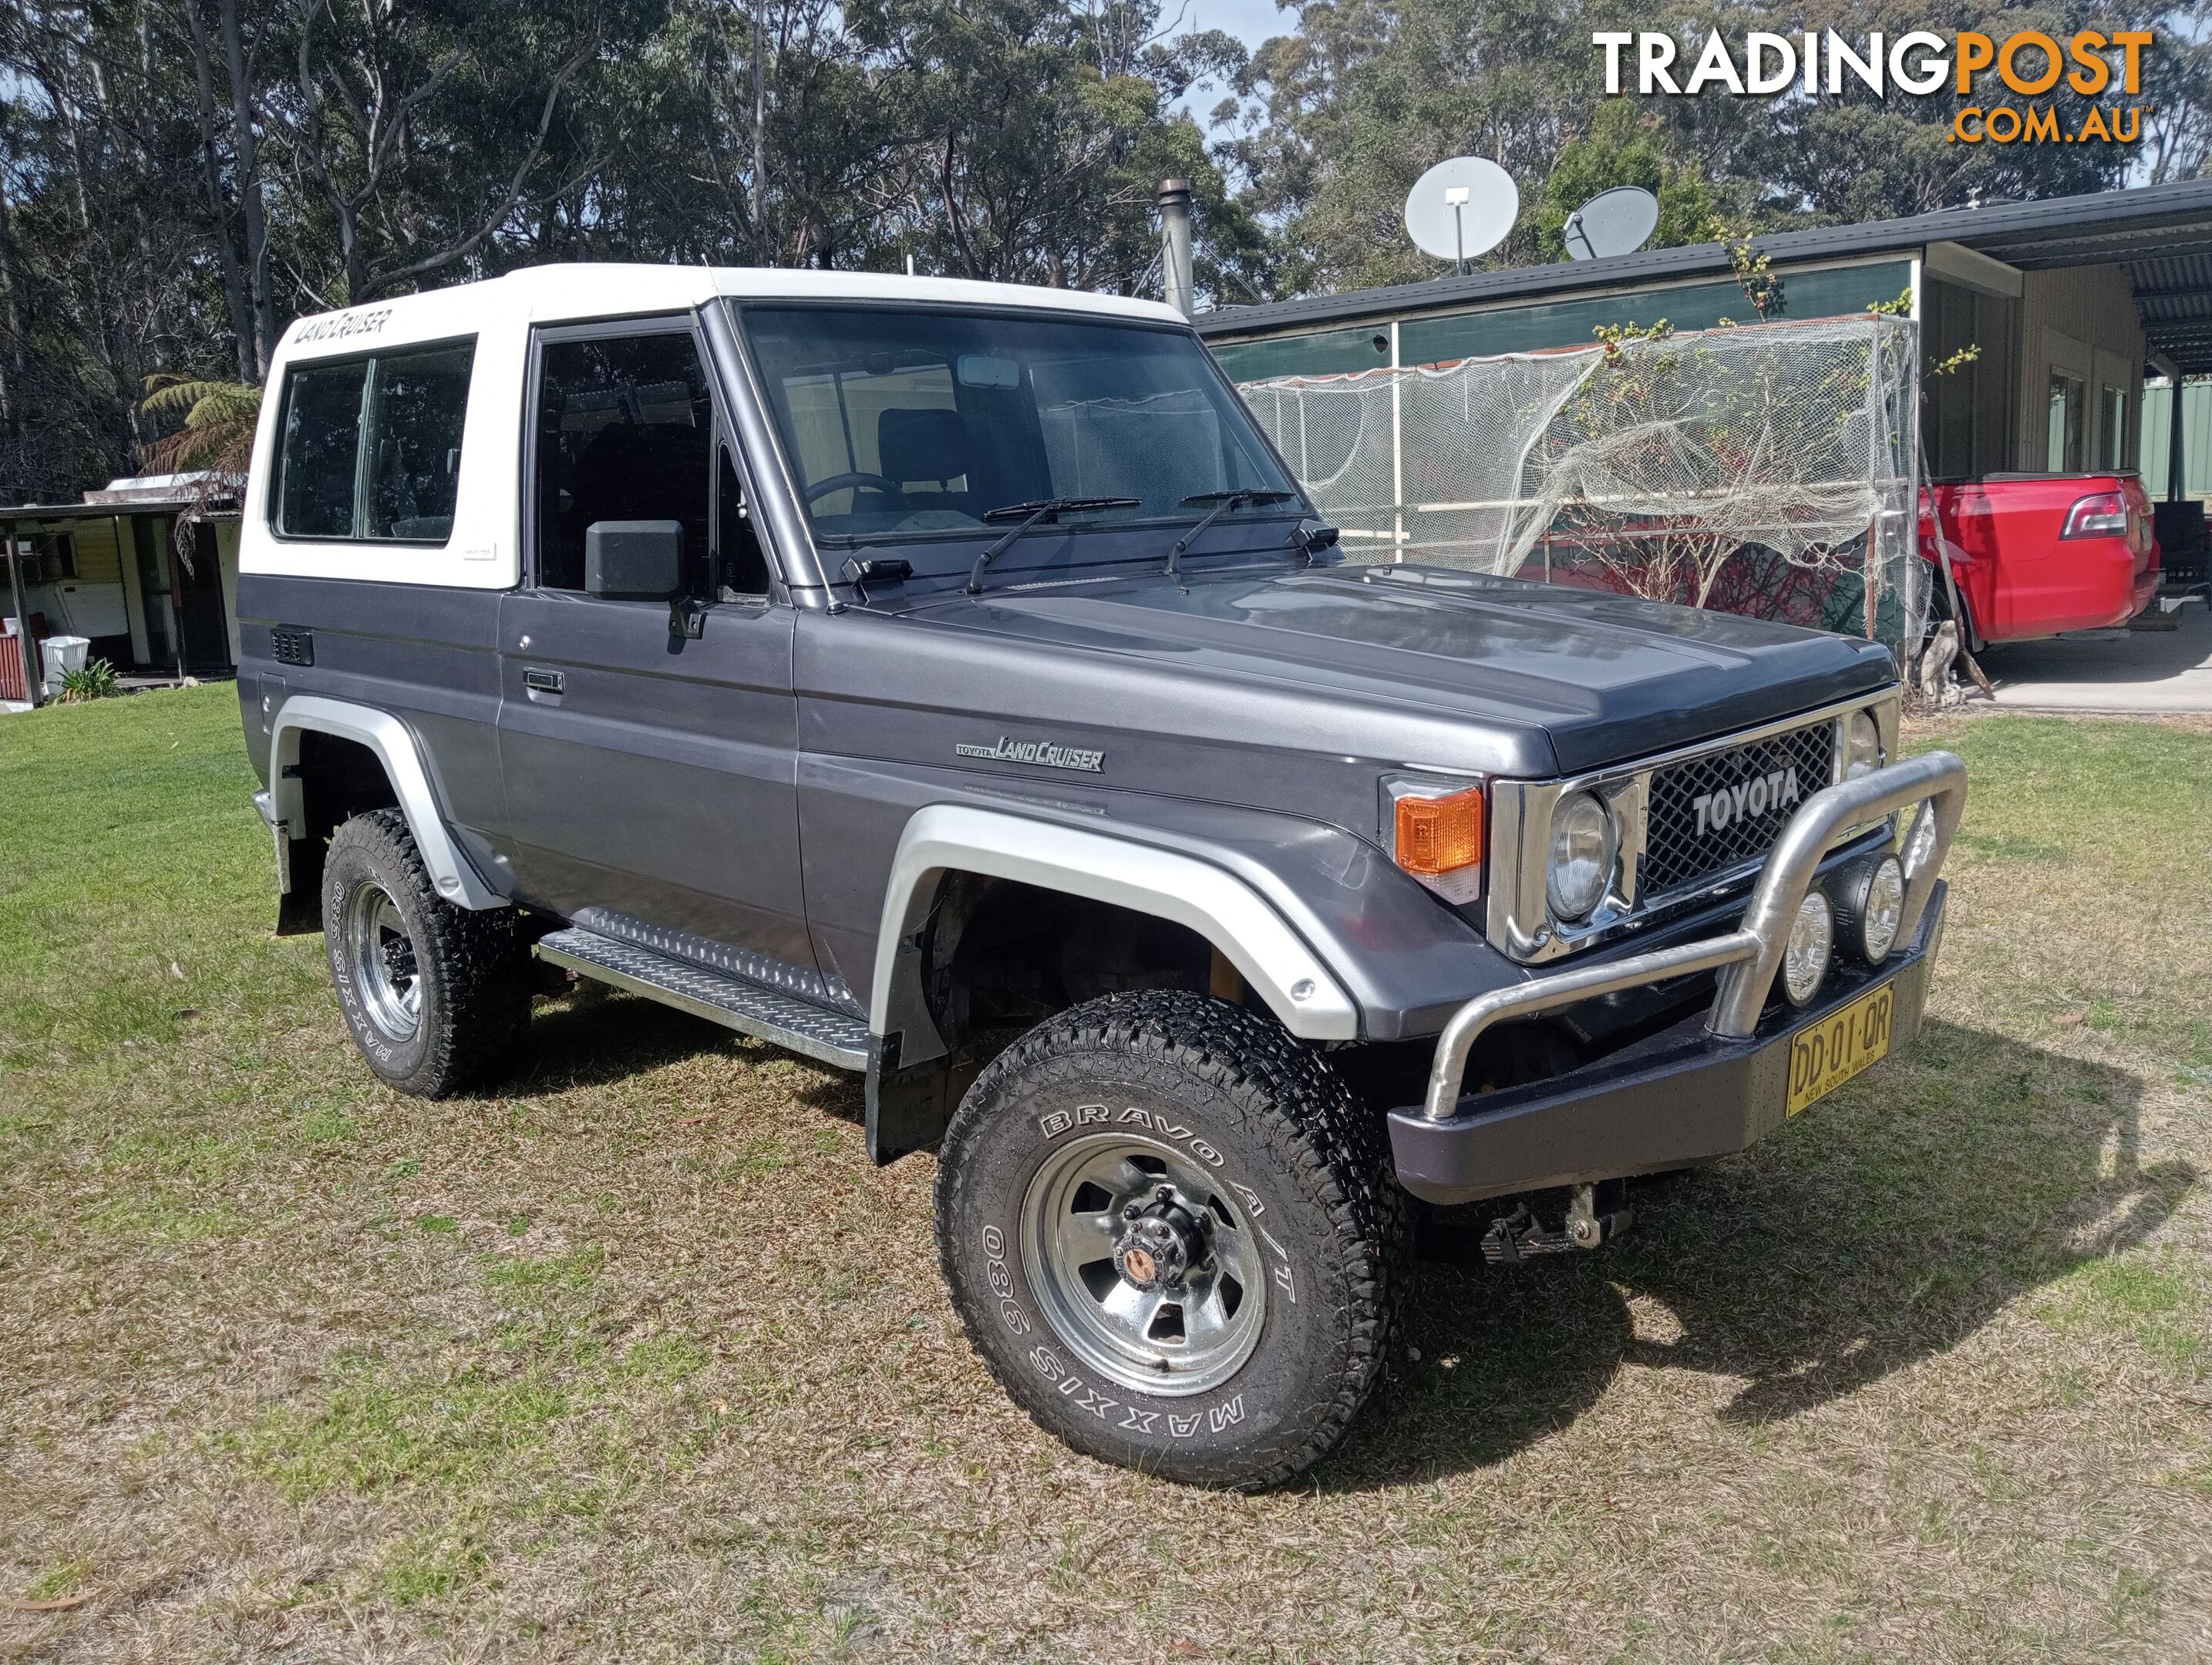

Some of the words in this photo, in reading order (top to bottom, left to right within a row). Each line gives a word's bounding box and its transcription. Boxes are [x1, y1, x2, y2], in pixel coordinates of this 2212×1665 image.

[957, 745, 992, 757] TOYOTA
[1693, 766, 1799, 836] TOYOTA
[333, 948, 393, 1062] MAXXIS
[1805, 1085, 1822, 1102] NEW
[1825, 1068, 1850, 1091] SOUTH
[1852, 1050, 1875, 1075] WALES
[1039, 1104, 1226, 1167] BRAVO
[982, 1224, 1032, 1336] 980
[1029, 1346, 1246, 1438] MAXXIS
